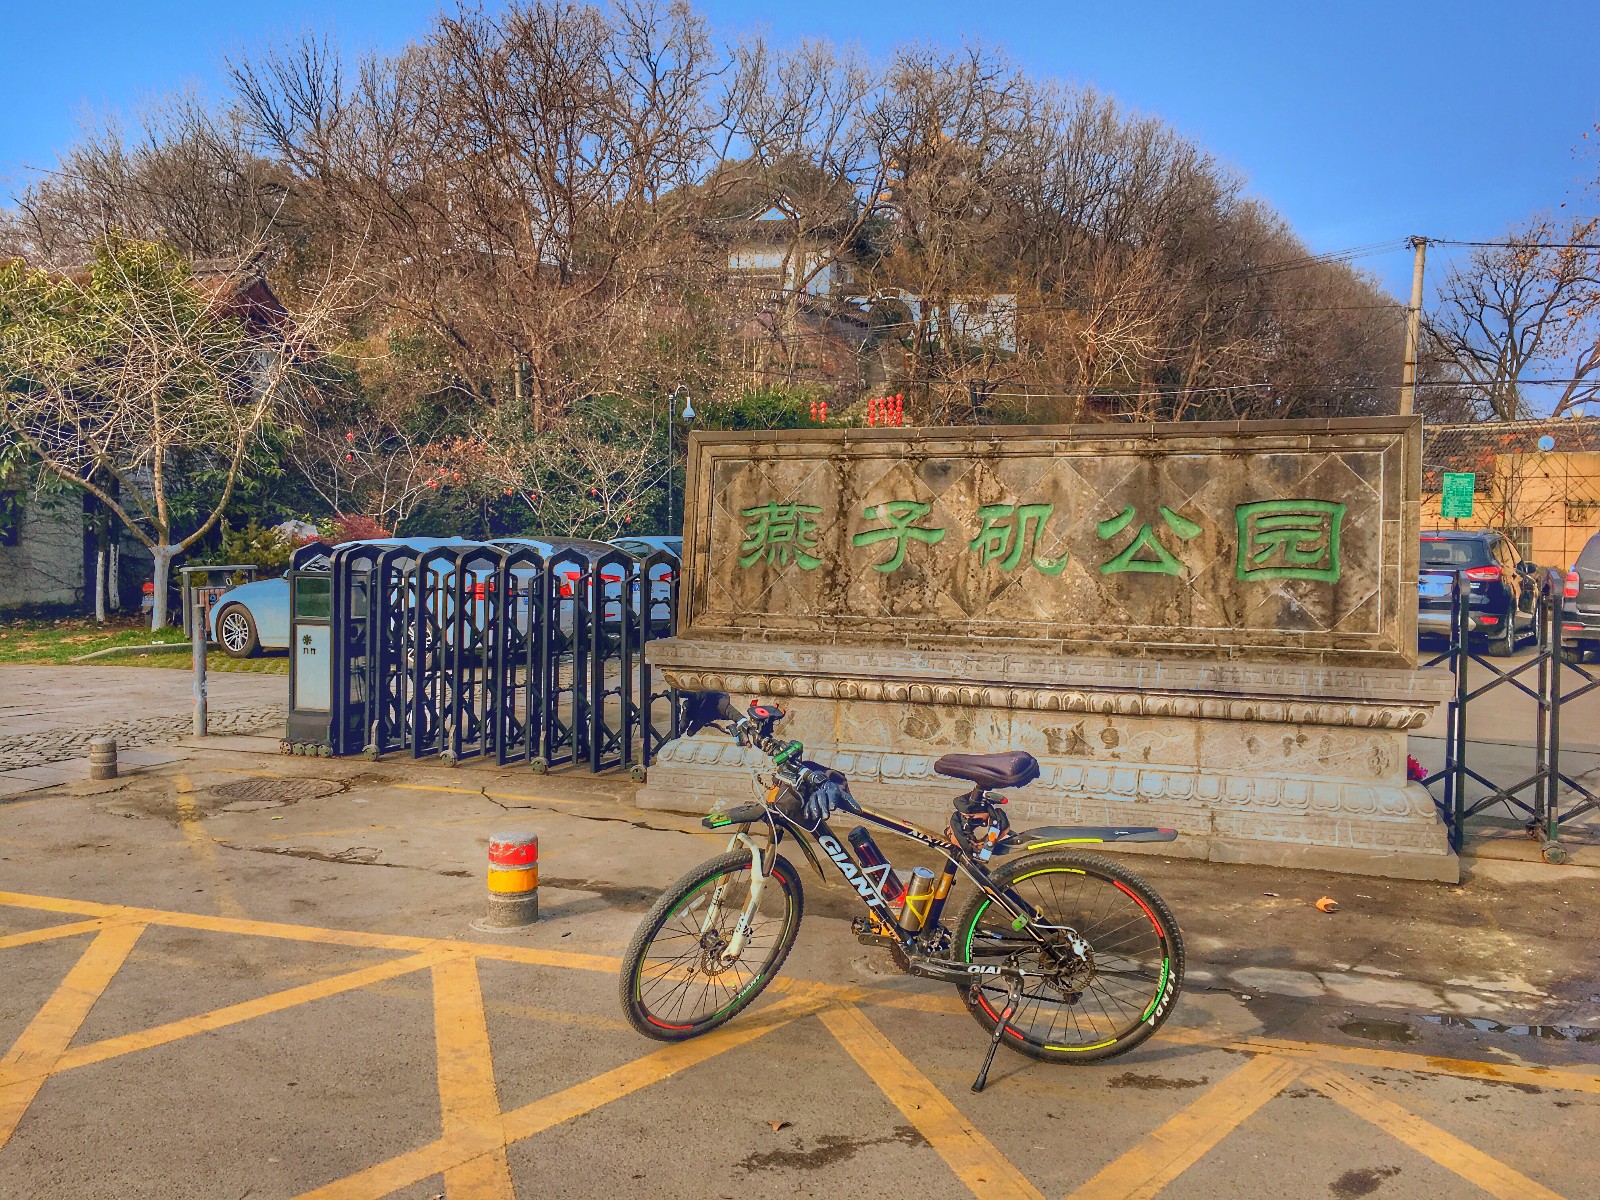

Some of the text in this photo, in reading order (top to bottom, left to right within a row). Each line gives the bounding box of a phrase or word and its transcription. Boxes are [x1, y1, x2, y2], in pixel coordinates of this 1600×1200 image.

[738, 497, 1346, 585] 燕子矶公园
[818, 834, 886, 910] GIANT
[1147, 969, 1176, 1027] KENDA
